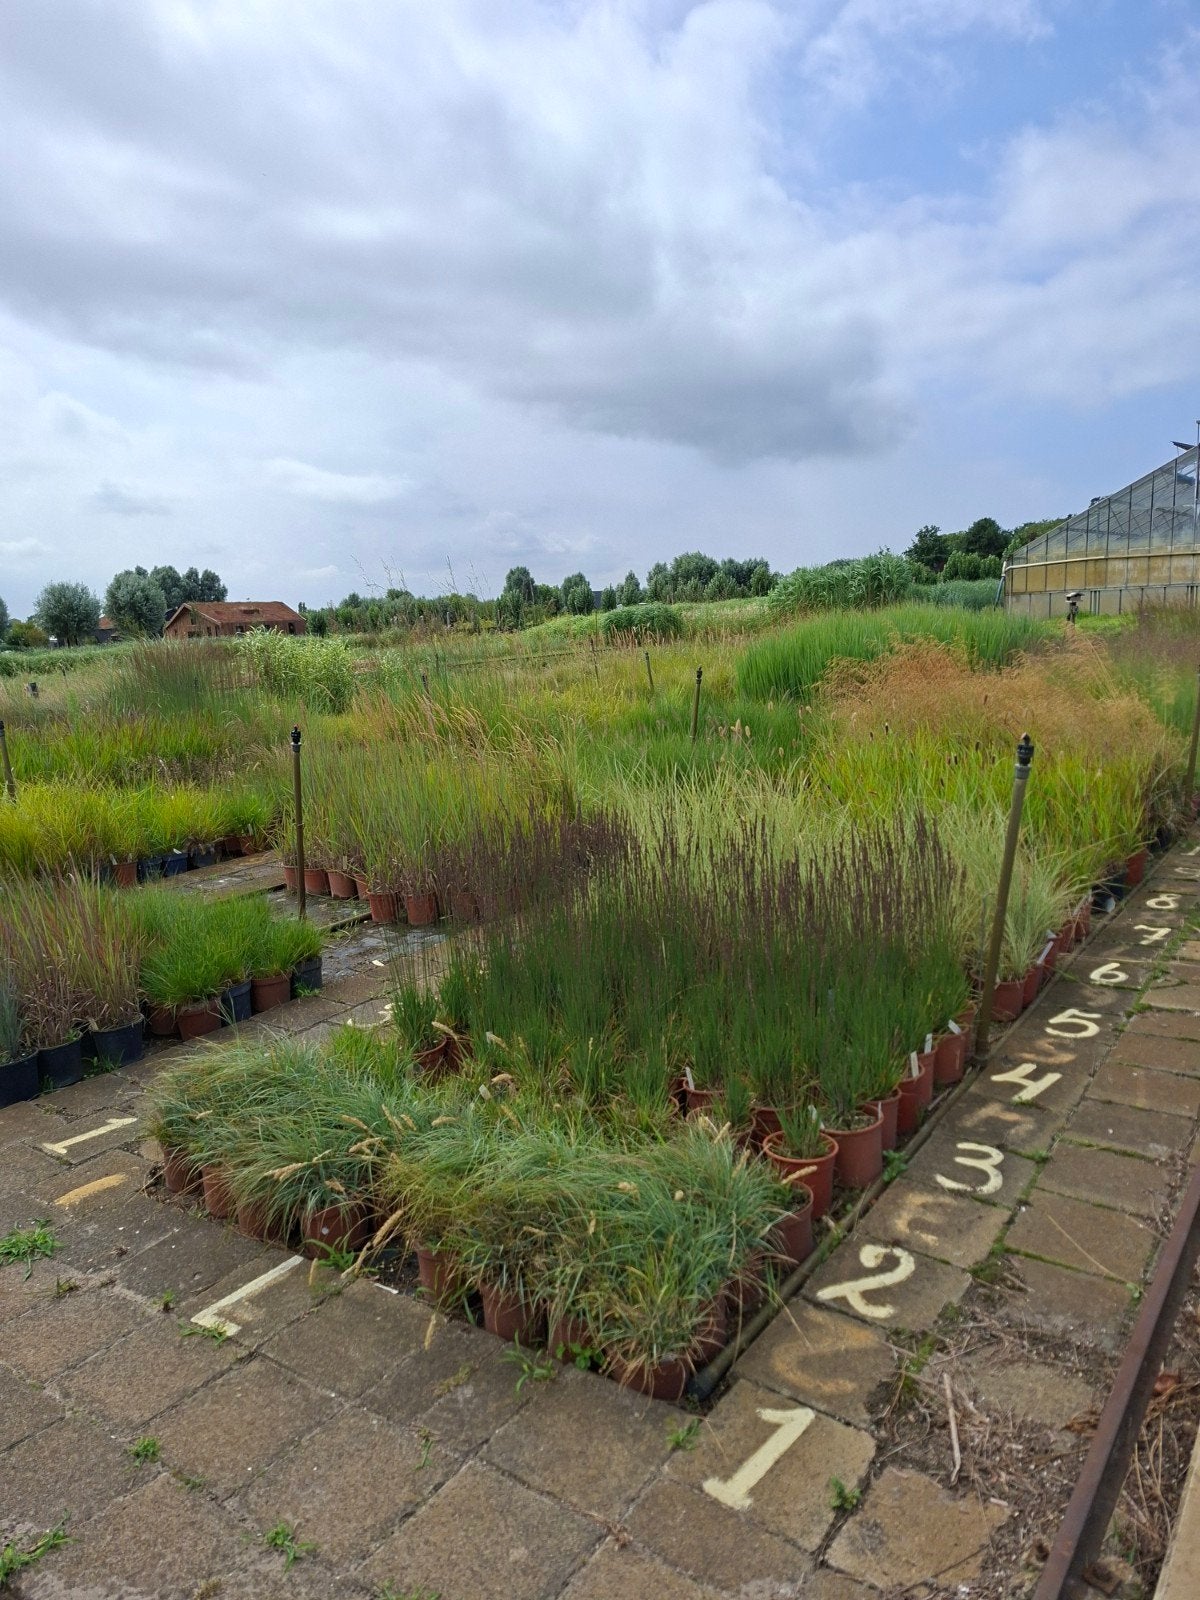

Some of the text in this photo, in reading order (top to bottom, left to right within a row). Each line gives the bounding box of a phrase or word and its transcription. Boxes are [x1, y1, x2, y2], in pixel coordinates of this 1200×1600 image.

[1146, 894, 1182, 909] 8
[1134, 924, 1171, 945] 7
[1089, 962, 1129, 984] 6
[1044, 1008, 1102, 1038] 5
[990, 1062, 1062, 1100] 4
[934, 1142, 1005, 1195] 3
[817, 1244, 915, 1319] 2
[703, 1407, 815, 1510] 1
